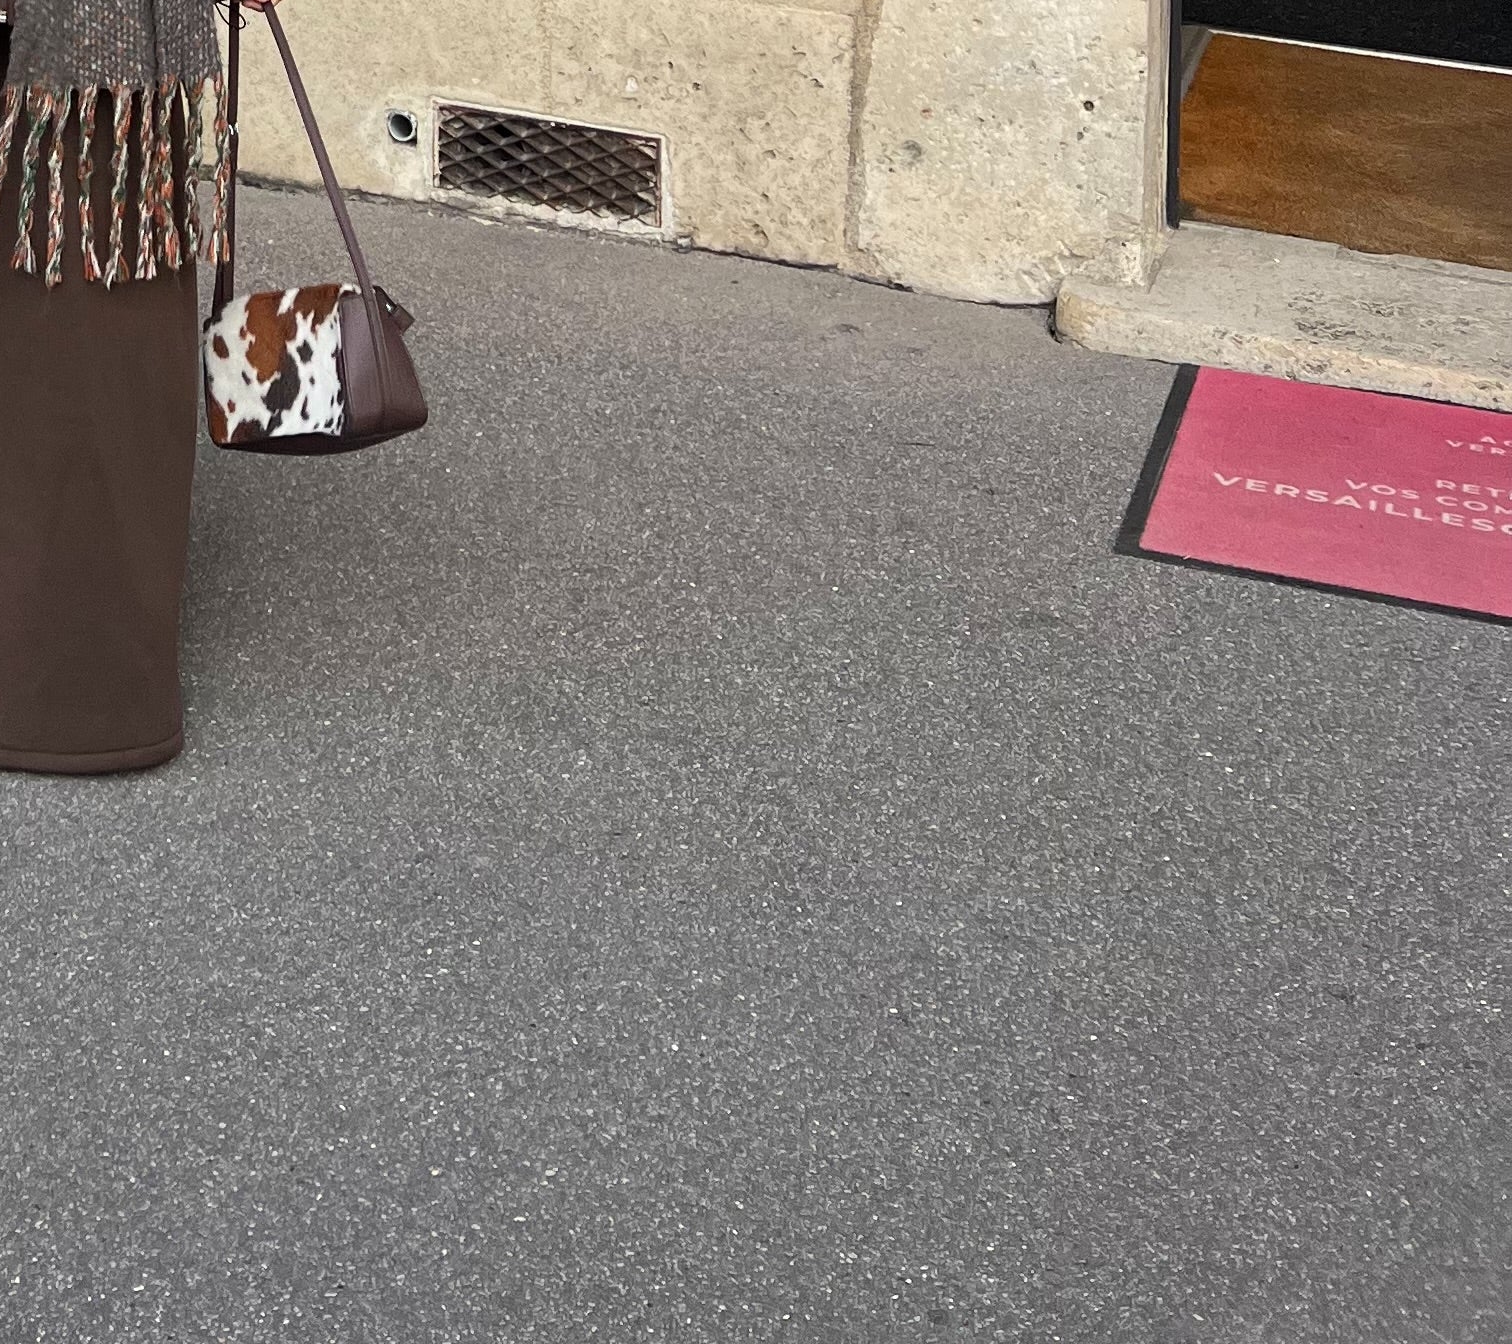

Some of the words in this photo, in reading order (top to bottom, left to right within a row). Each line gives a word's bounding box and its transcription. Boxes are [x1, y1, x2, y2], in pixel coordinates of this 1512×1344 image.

[1445, 439, 1512, 457] VER
[1344, 478, 1420, 500] VOS
[1435, 479, 1512, 500] RET
